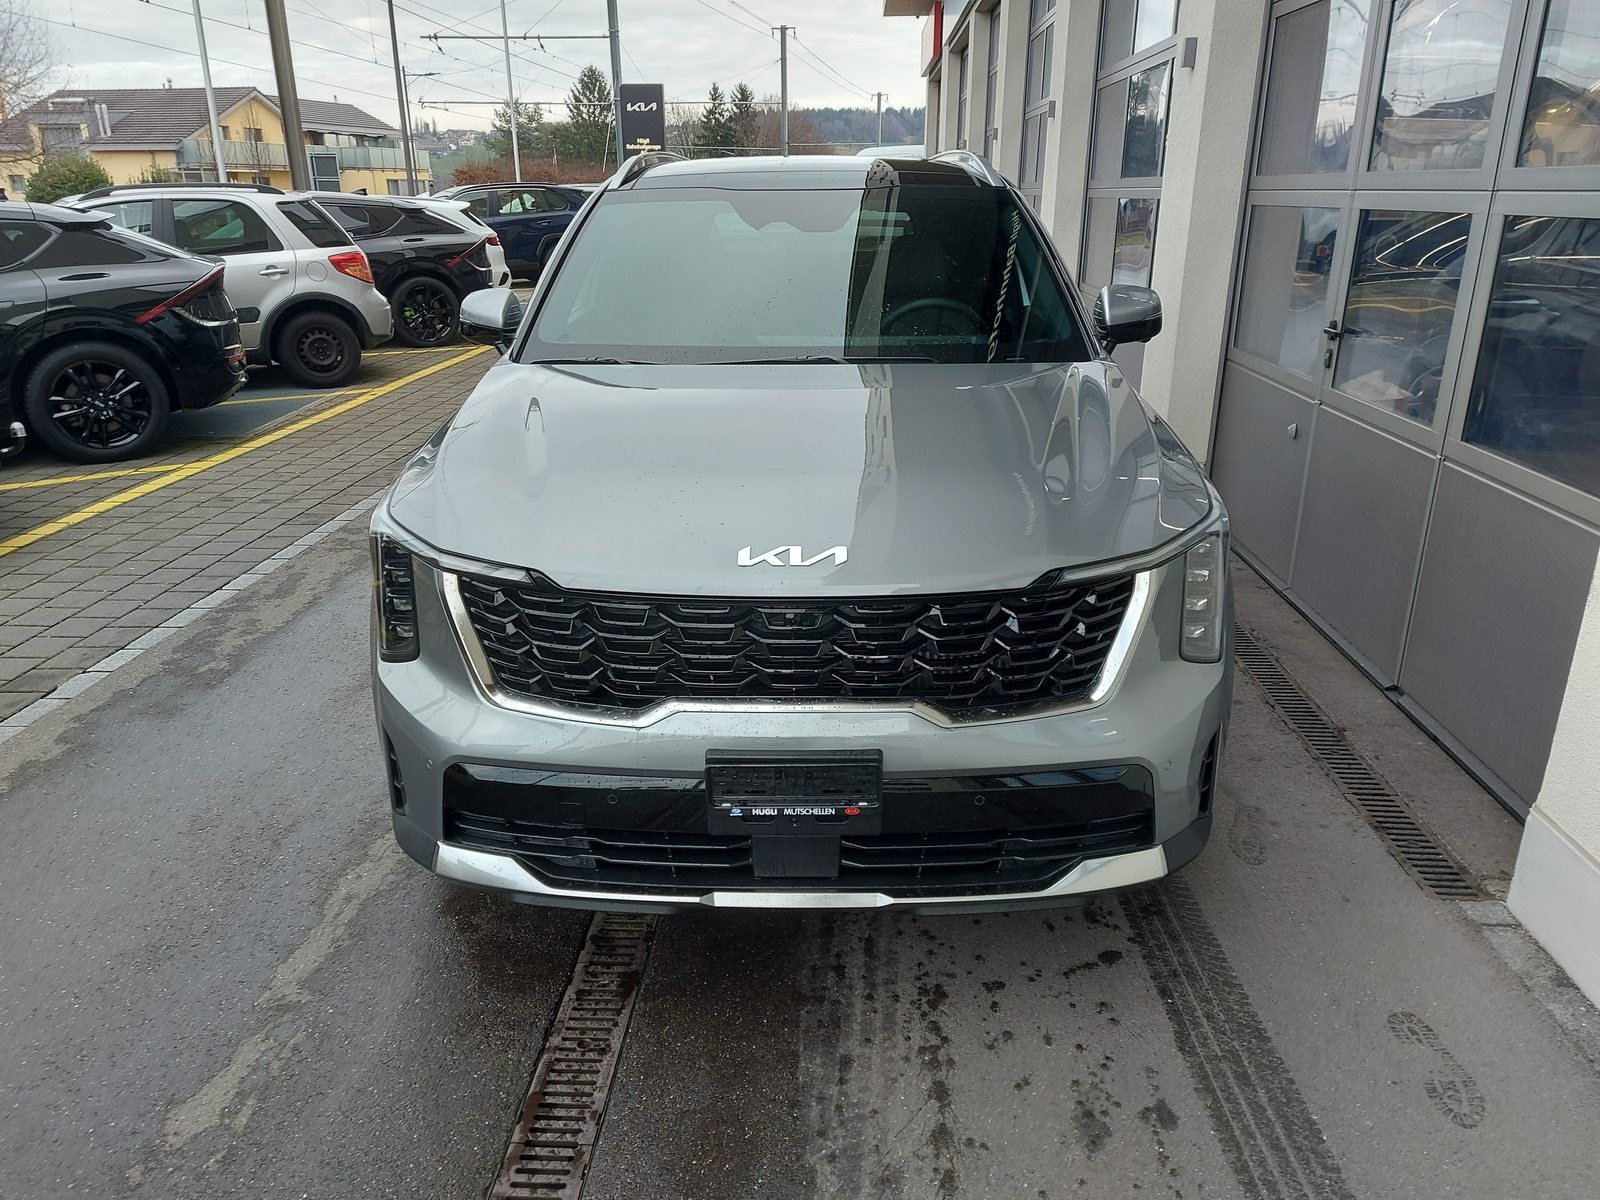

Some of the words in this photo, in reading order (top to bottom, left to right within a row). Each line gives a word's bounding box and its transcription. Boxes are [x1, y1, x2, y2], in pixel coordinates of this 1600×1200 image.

[626, 103, 657, 111] KIA
[737, 545, 848, 567] KIA
[783, 808, 835, 816] MUTSCHELLEN
